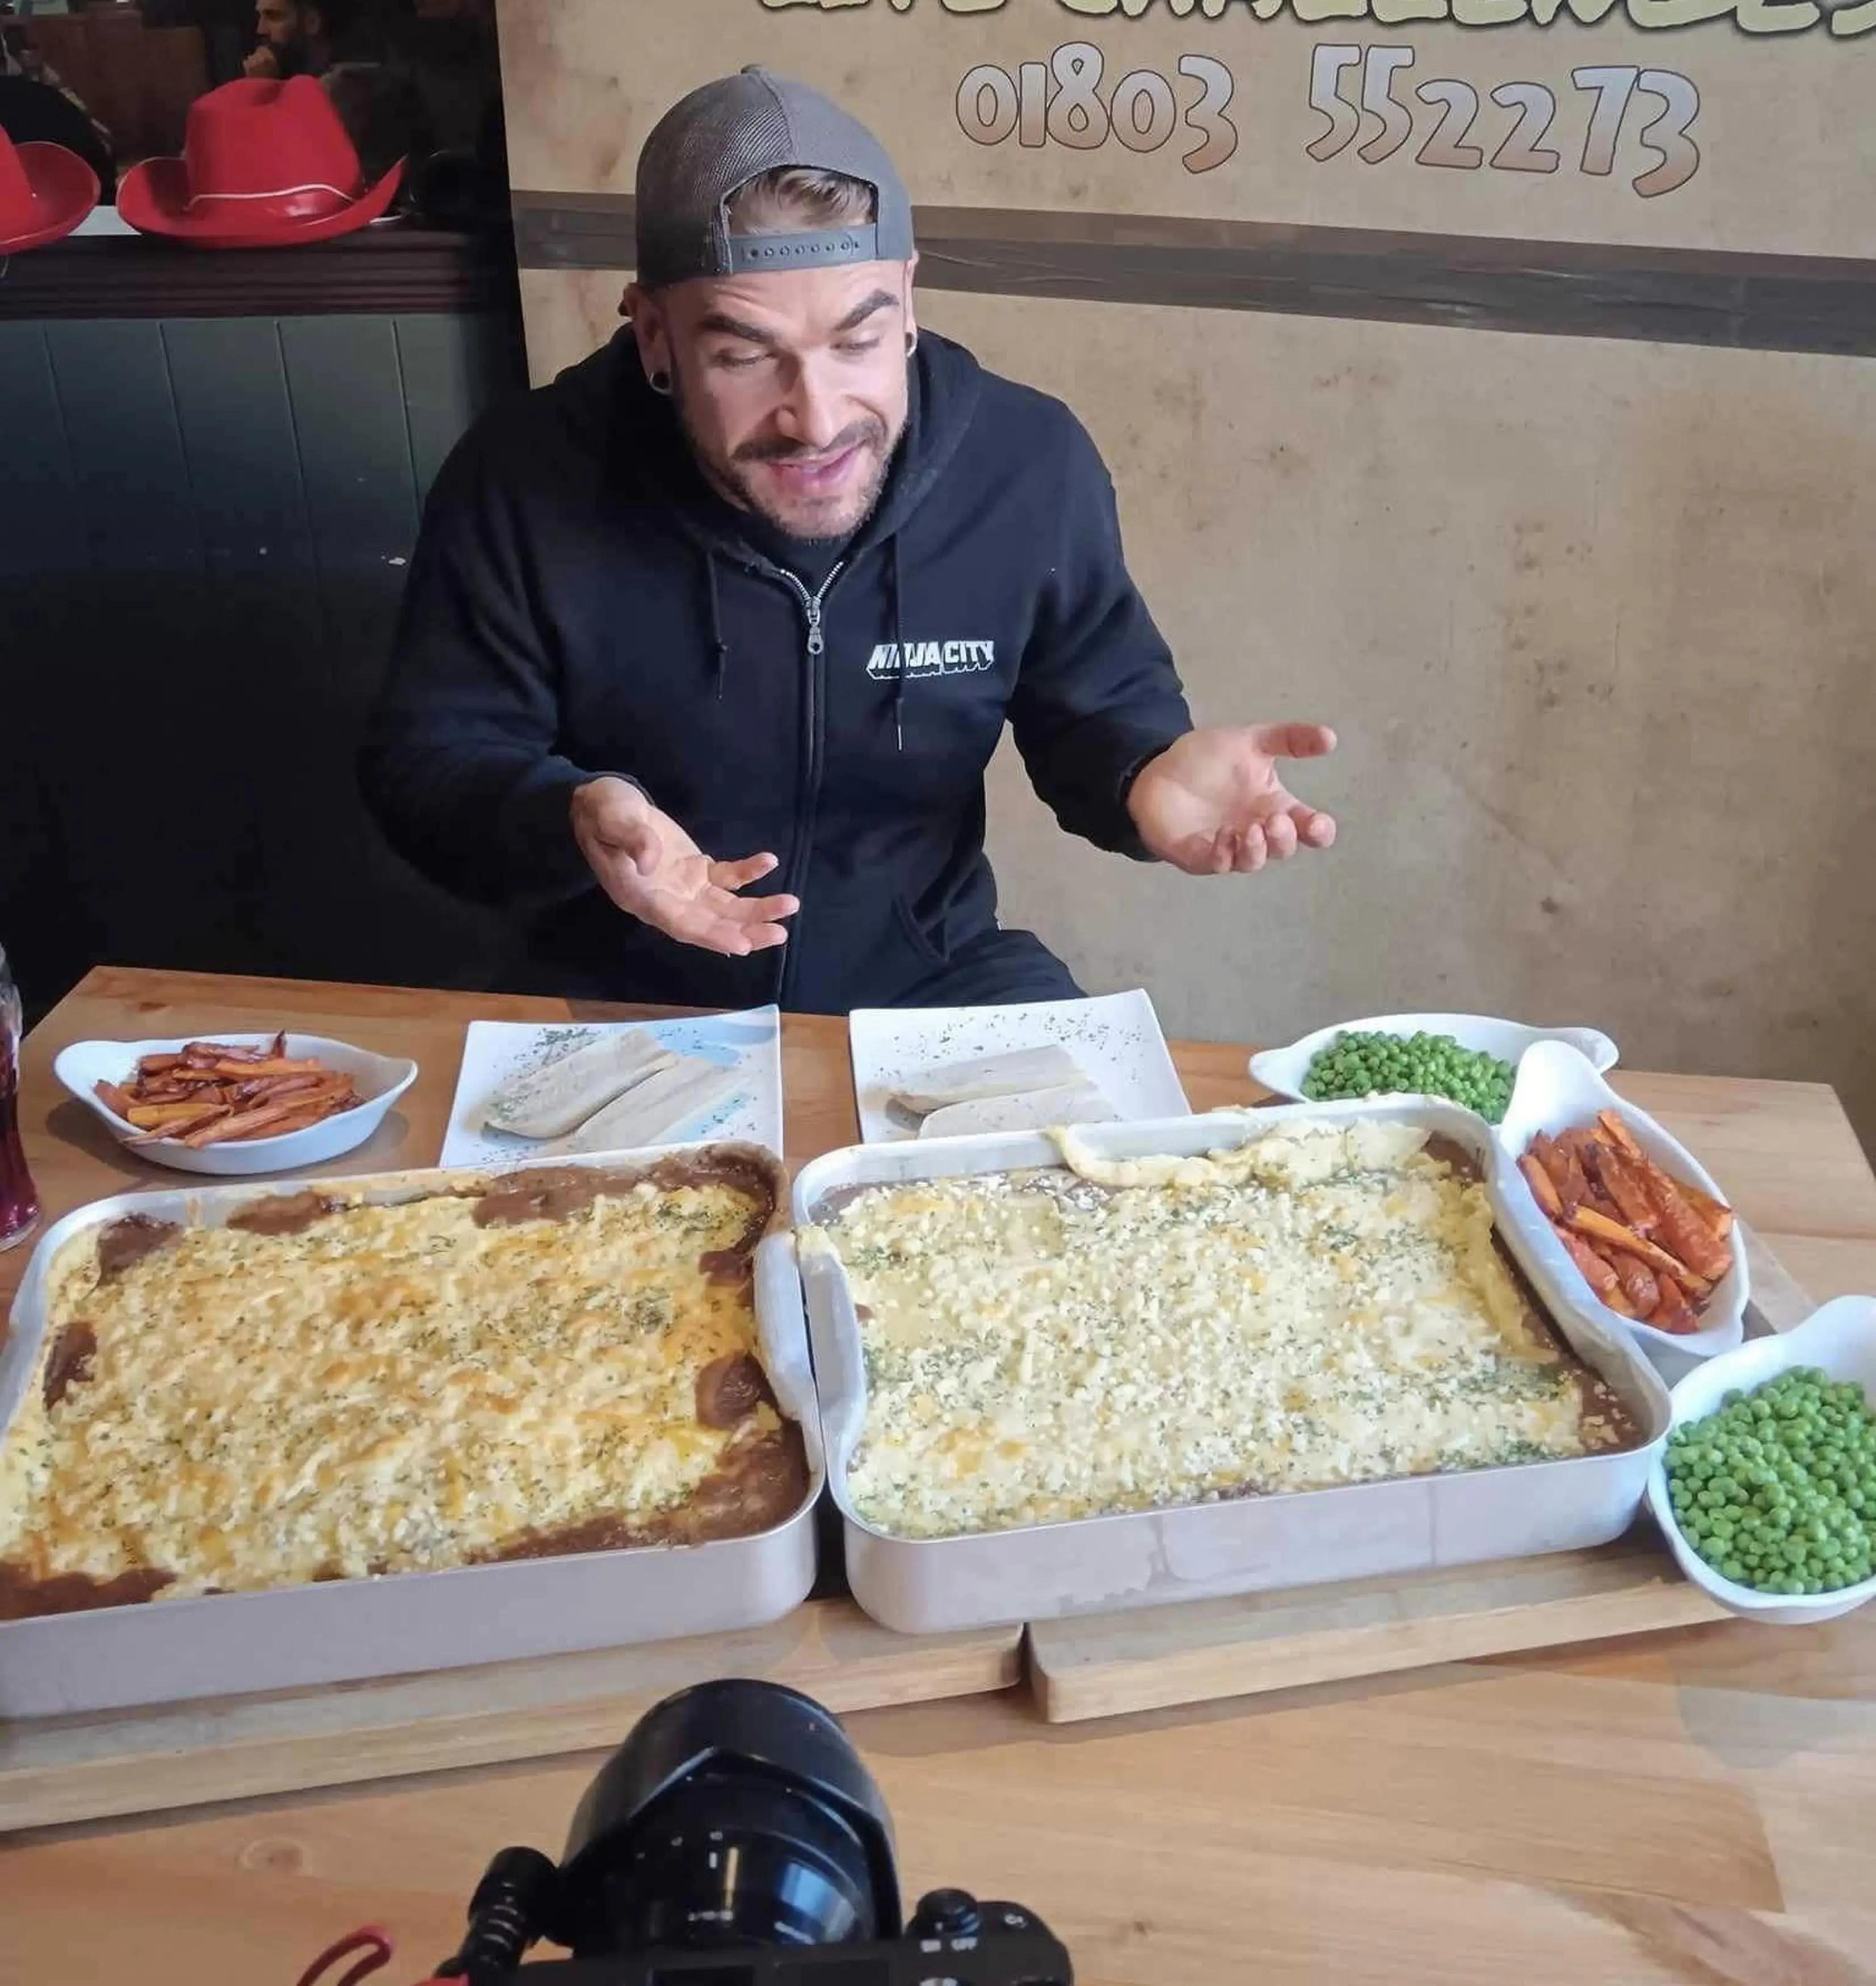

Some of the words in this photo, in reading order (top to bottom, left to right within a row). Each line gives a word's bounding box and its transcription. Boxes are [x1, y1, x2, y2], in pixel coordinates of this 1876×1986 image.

[956, 41, 1239, 174] 01803
[1305, 43, 1701, 198] 552273
[942, 640, 994, 672] CITY
